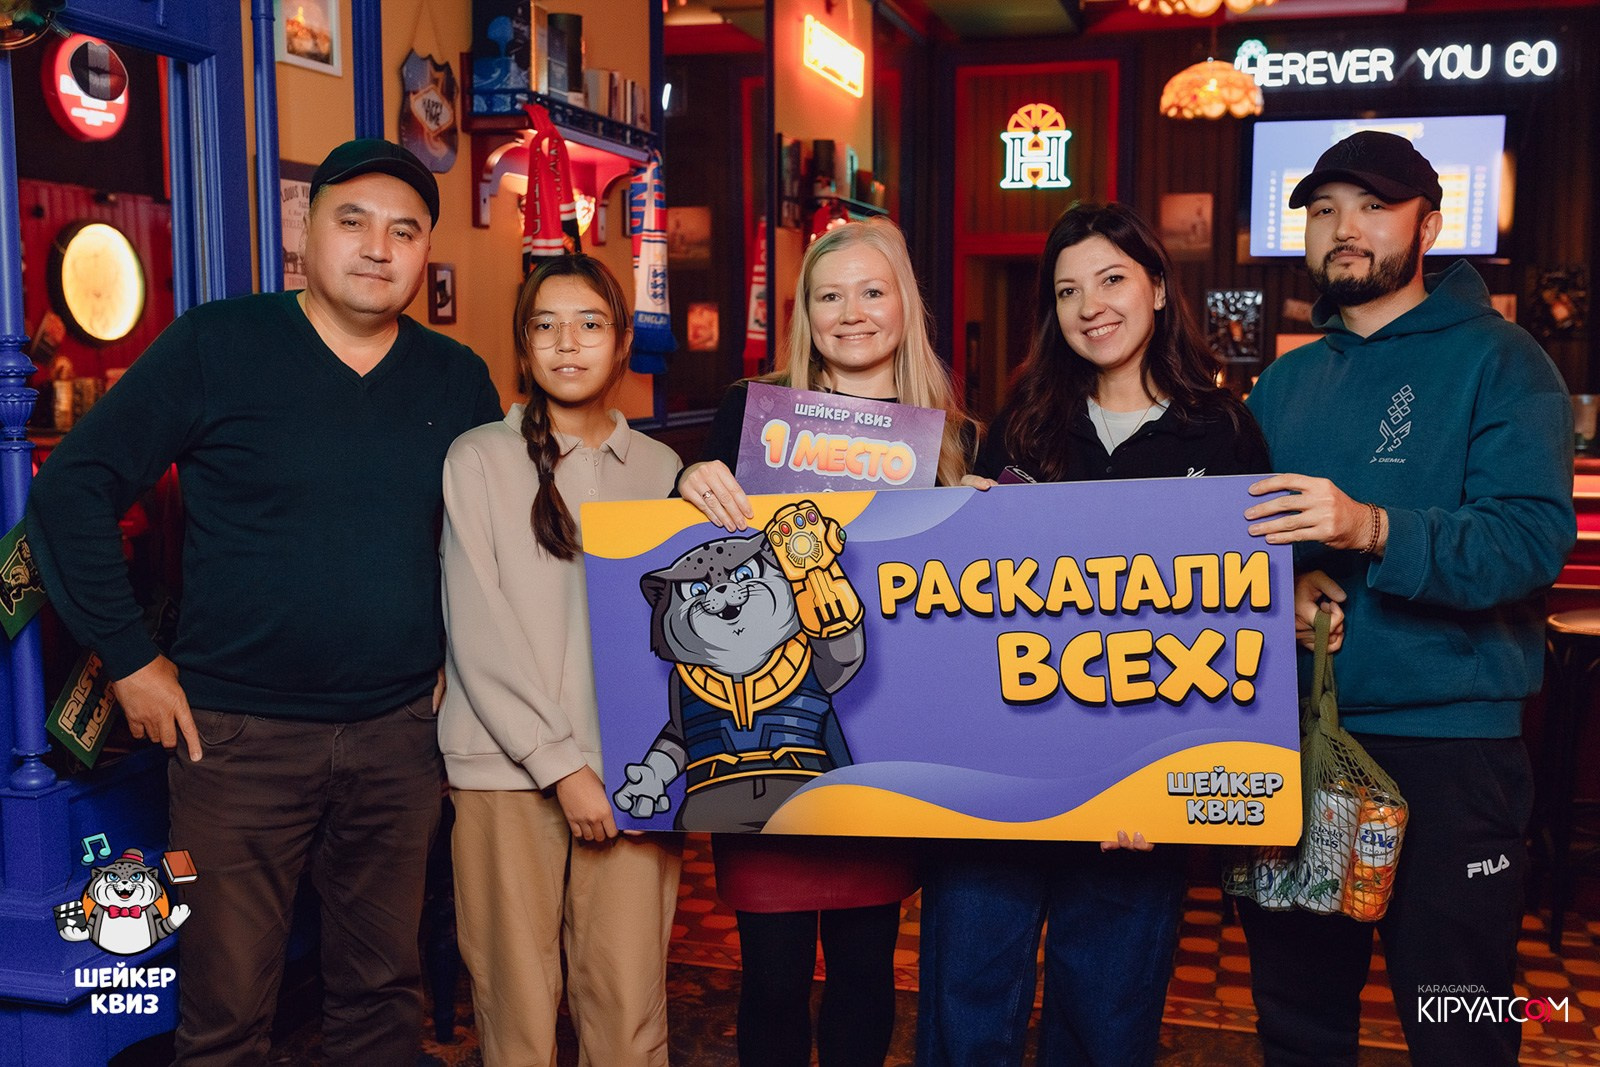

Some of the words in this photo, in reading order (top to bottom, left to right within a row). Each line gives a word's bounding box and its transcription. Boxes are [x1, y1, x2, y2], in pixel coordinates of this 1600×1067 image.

[1234, 48, 1395, 87] HEREVER
[1416, 43, 1492, 80] YOU
[1504, 39, 1558, 78] GO
[1000, 130, 1072, 189] H
[794, 403, 850, 422] ШЕЙКЕР
[854, 413, 893, 428] КВИЗ
[762, 420, 790, 467] 1
[790, 431, 915, 484] МЕСТО
[877, 551, 1271, 618] РАСКАТАЛИ
[60, 654, 103, 731] IRISH
[997, 628, 1264, 707] ВСЕХ!
[1167, 766, 1284, 798] ШЕЙКЕР
[1186, 799, 1265, 826] КВИЗ
[1466, 854, 1510, 879] FILA
